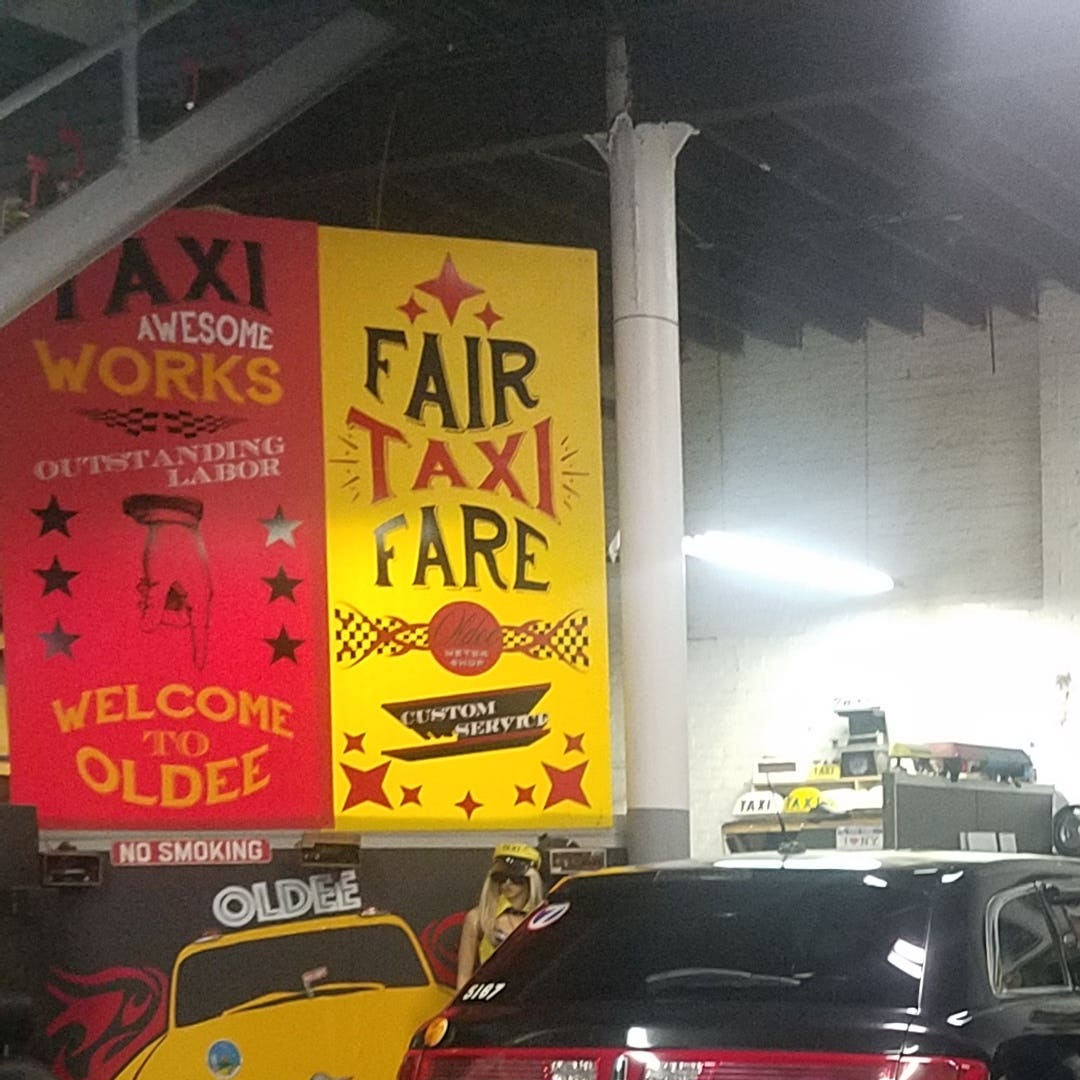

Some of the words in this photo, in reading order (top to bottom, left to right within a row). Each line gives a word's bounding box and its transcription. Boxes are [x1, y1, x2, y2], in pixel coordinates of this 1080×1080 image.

[137, 311, 274, 350] AWESOME
[33, 339, 284, 405] WORKS
[364, 326, 540, 431] FAIR
[33, 436, 286, 481] OUTSTANDING
[167, 458, 281, 488] LABOR
[346, 406, 560, 524] TAXI
[374, 503, 550, 592] FARE
[52, 683, 294, 739] WELCOME
[400, 700, 496, 726] CUSTOM
[453, 713, 549, 737] SERVICE
[142, 730, 209, 757] TO
[75, 744, 271, 809] OLDEE
[740, 799, 771, 812] TAXI
[119, 843, 151, 862] NO
[158, 840, 263, 862] SMOKING
[212, 869, 362, 927] OLDEE
